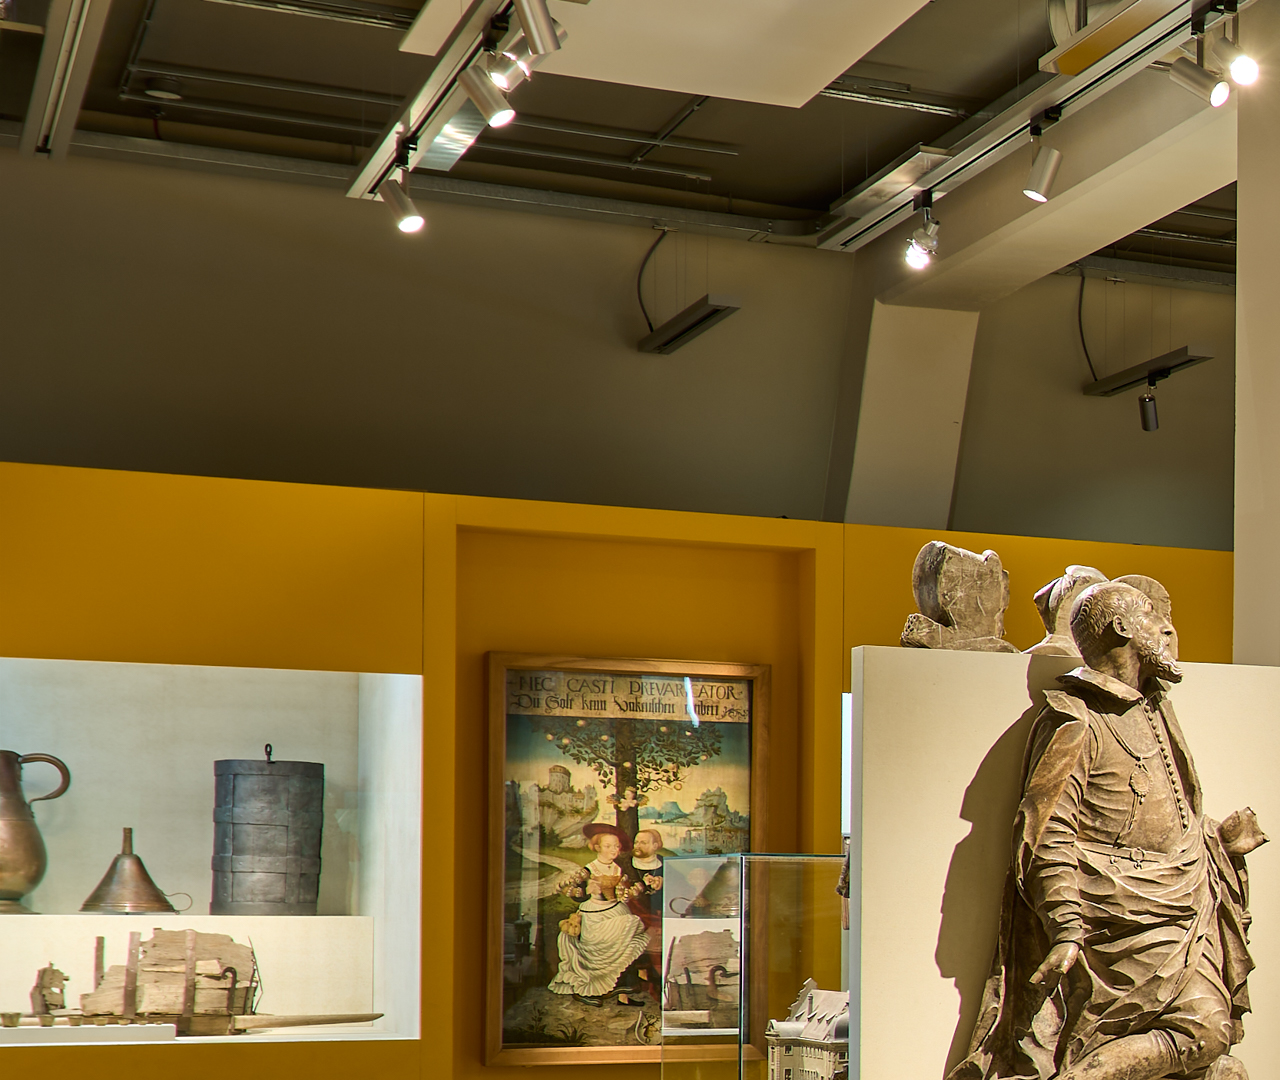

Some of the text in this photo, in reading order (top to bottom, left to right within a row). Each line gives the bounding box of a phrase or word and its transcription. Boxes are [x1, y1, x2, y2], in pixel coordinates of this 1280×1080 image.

[519, 676, 739, 700] NEC CASTI PREVARCATOR
